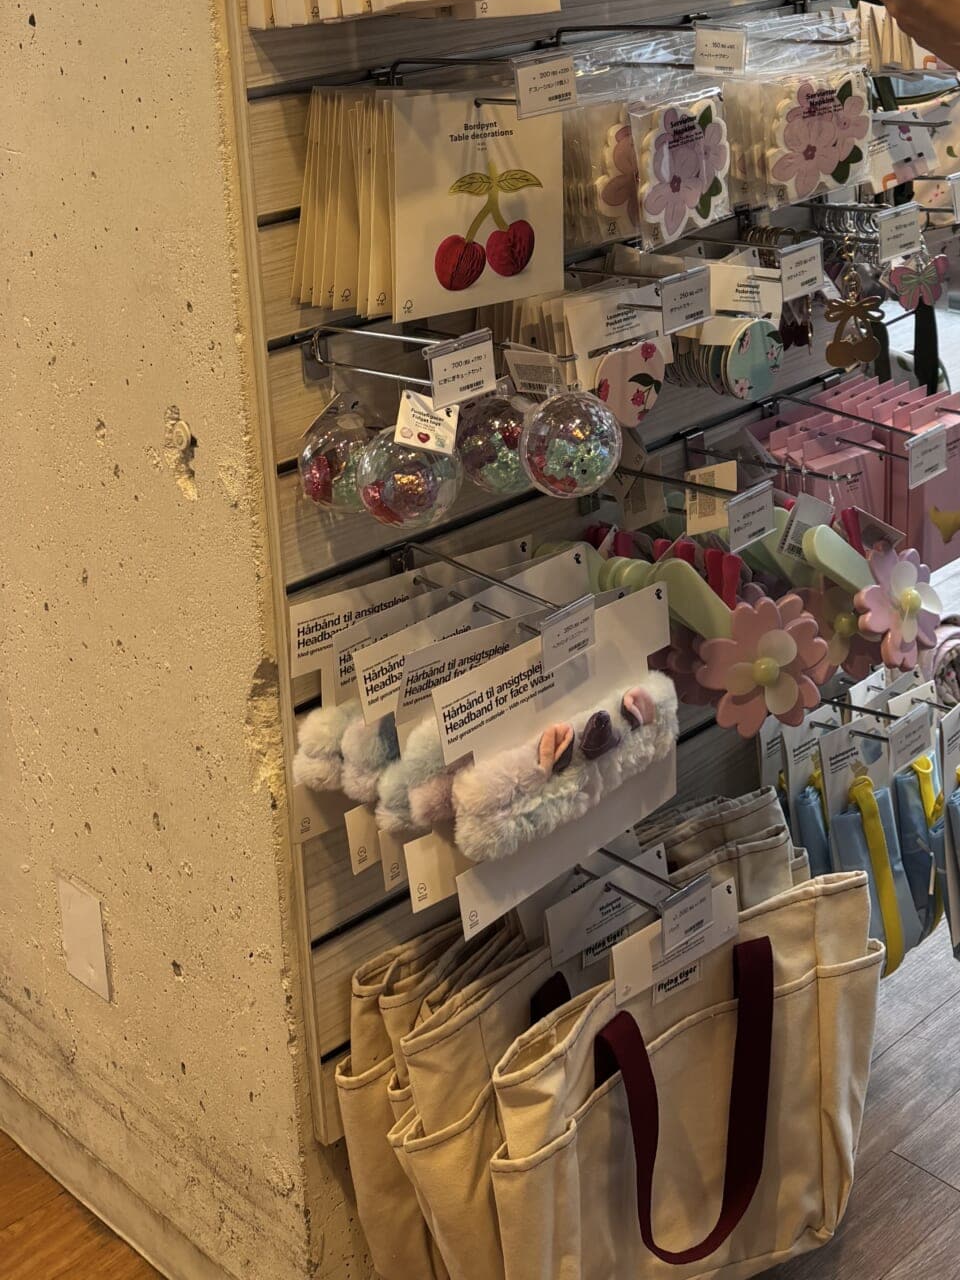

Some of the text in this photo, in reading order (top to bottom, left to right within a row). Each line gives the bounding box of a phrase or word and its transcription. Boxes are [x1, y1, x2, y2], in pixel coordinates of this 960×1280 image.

[809, 96, 836, 108] Napkins
[448, 128, 514, 143] Table decorations
[463, 120, 498, 132] Bordpynt
[606, 318, 622, 328] Pocket
[451, 360, 463, 368] 700
[297, 615, 341, 638] Hårbånd
[343, 611, 353, 623] til
[363, 655, 406, 685] Hårbånd
[405, 664, 447, 687] Hårbånd
[447, 658, 457, 673] til
[457, 642, 510, 669] ansigtspleje
[404, 673, 452, 699] Headband
[442, 694, 484, 723] Hårbånd
[485, 685, 495, 700] til
[445, 704, 493, 736] Headband
[494, 693, 509, 710] for
[510, 683, 529, 701] face
[447, 734, 459, 745] Med
[606, 928, 625, 945] tiger
[657, 965, 698, 992] flying tiger
